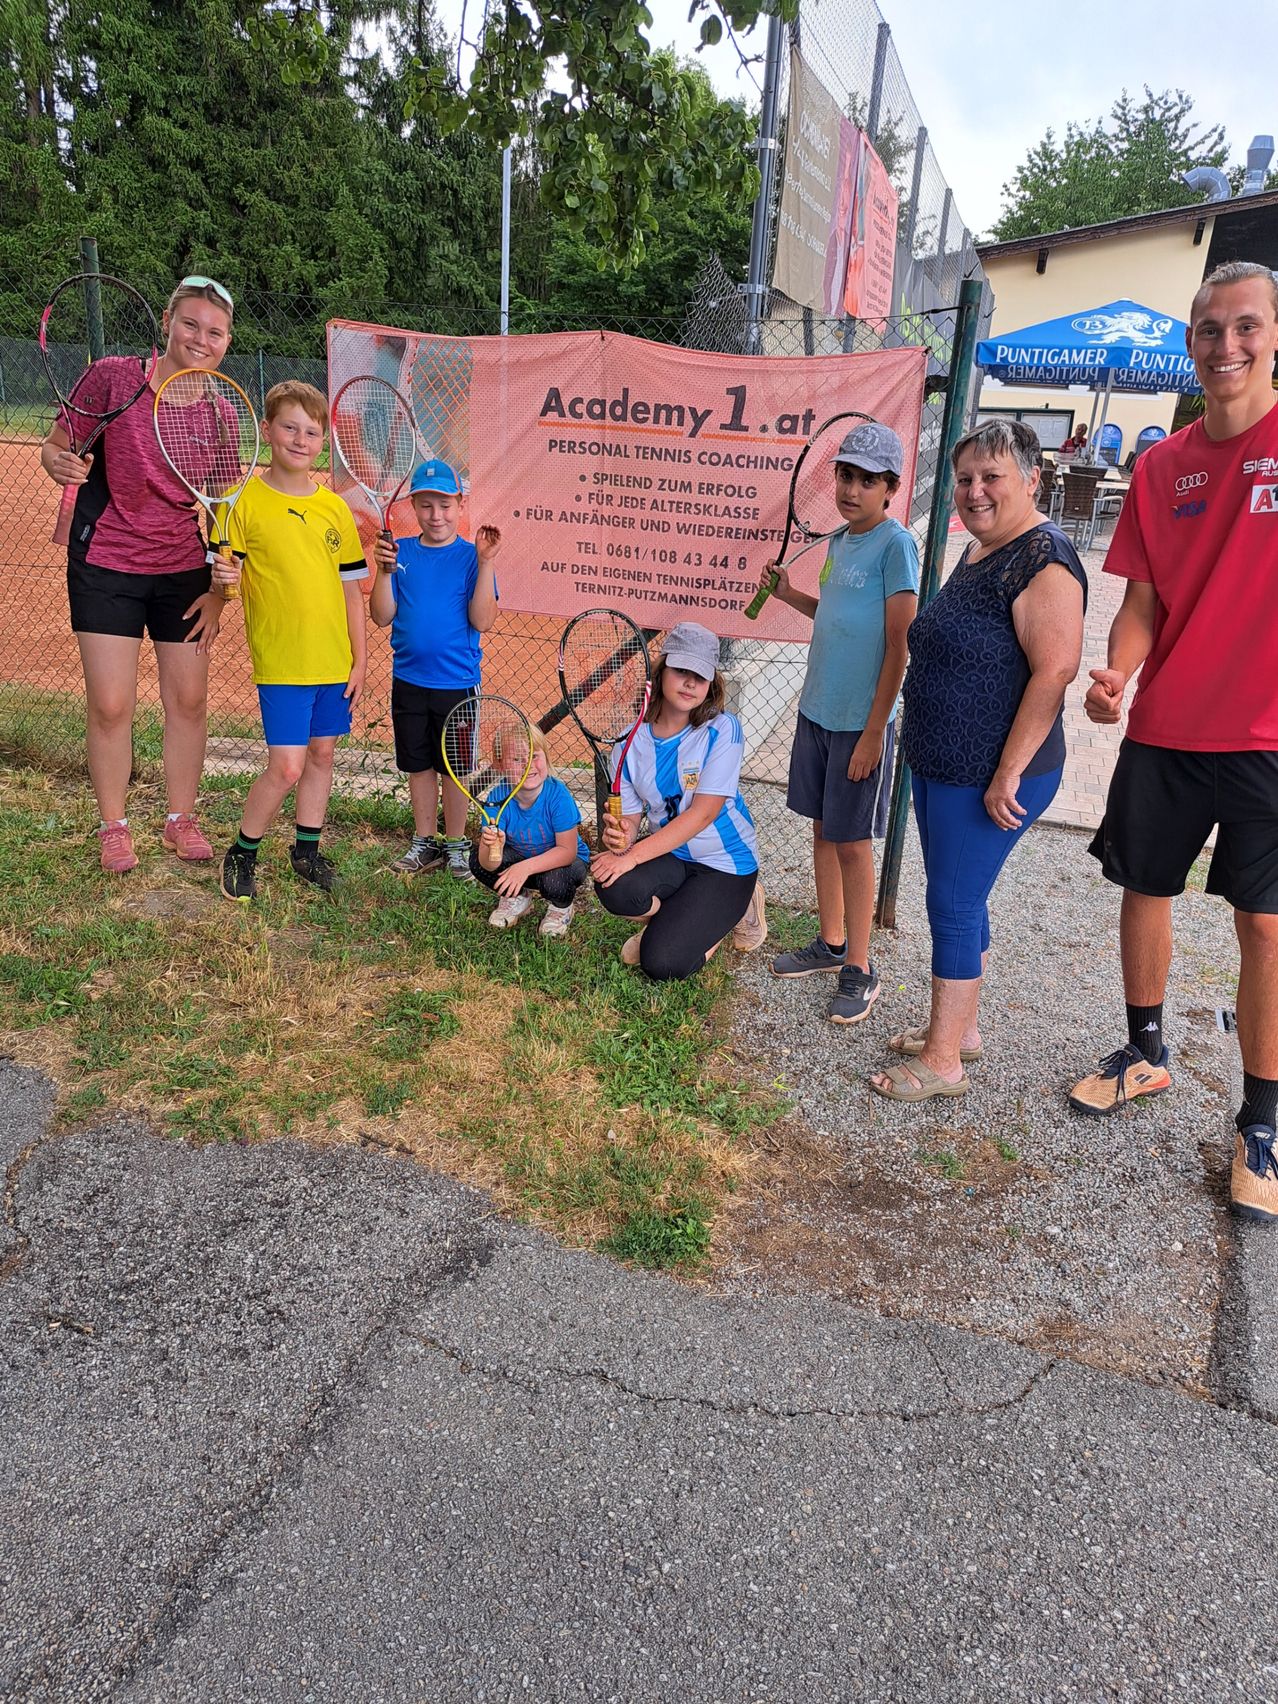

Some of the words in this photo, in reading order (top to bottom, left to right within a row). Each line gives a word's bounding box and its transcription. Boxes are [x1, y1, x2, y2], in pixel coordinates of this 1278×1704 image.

[996, 345, 1108, 365] PUNTIGAMER
[1129, 350, 1196, 372] PUNTIG
[539, 387, 713, 438] Academy
[548, 439, 631, 459] PERSONAL
[634, 446, 692, 465] TENNIS
[697, 451, 794, 472] COACHING
[592, 472, 653, 490] SPIELEND
[657, 478, 693, 494] ZUM
[697, 482, 758, 500] ERFOLG
[588, 489, 613, 507] FÜR
[616, 495, 647, 511] JEDE
[650, 499, 760, 521] ALTERSKLASSE
[1173, 500, 1206, 517] VISA
[526, 505, 554, 522] FÜR
[558, 508, 636, 530] ANFÄNGER
[640, 518, 671, 533] UND
[676, 521, 817, 545] WIEDEREINSTEGE
[606, 543, 678, 564] 0681/108
[683, 552, 703, 567] 43
[709, 554, 729, 570] 44
[737, 556, 748, 571] 8
[541, 561, 567, 574] AUF
[571, 564, 599, 577] DEN
[602, 567, 652, 584] EIGENEN
[656, 573, 759, 595] TENNISPLÄTZEN
[574, 581, 746, 612] TERNITZ-PUTZMANNSDORF
